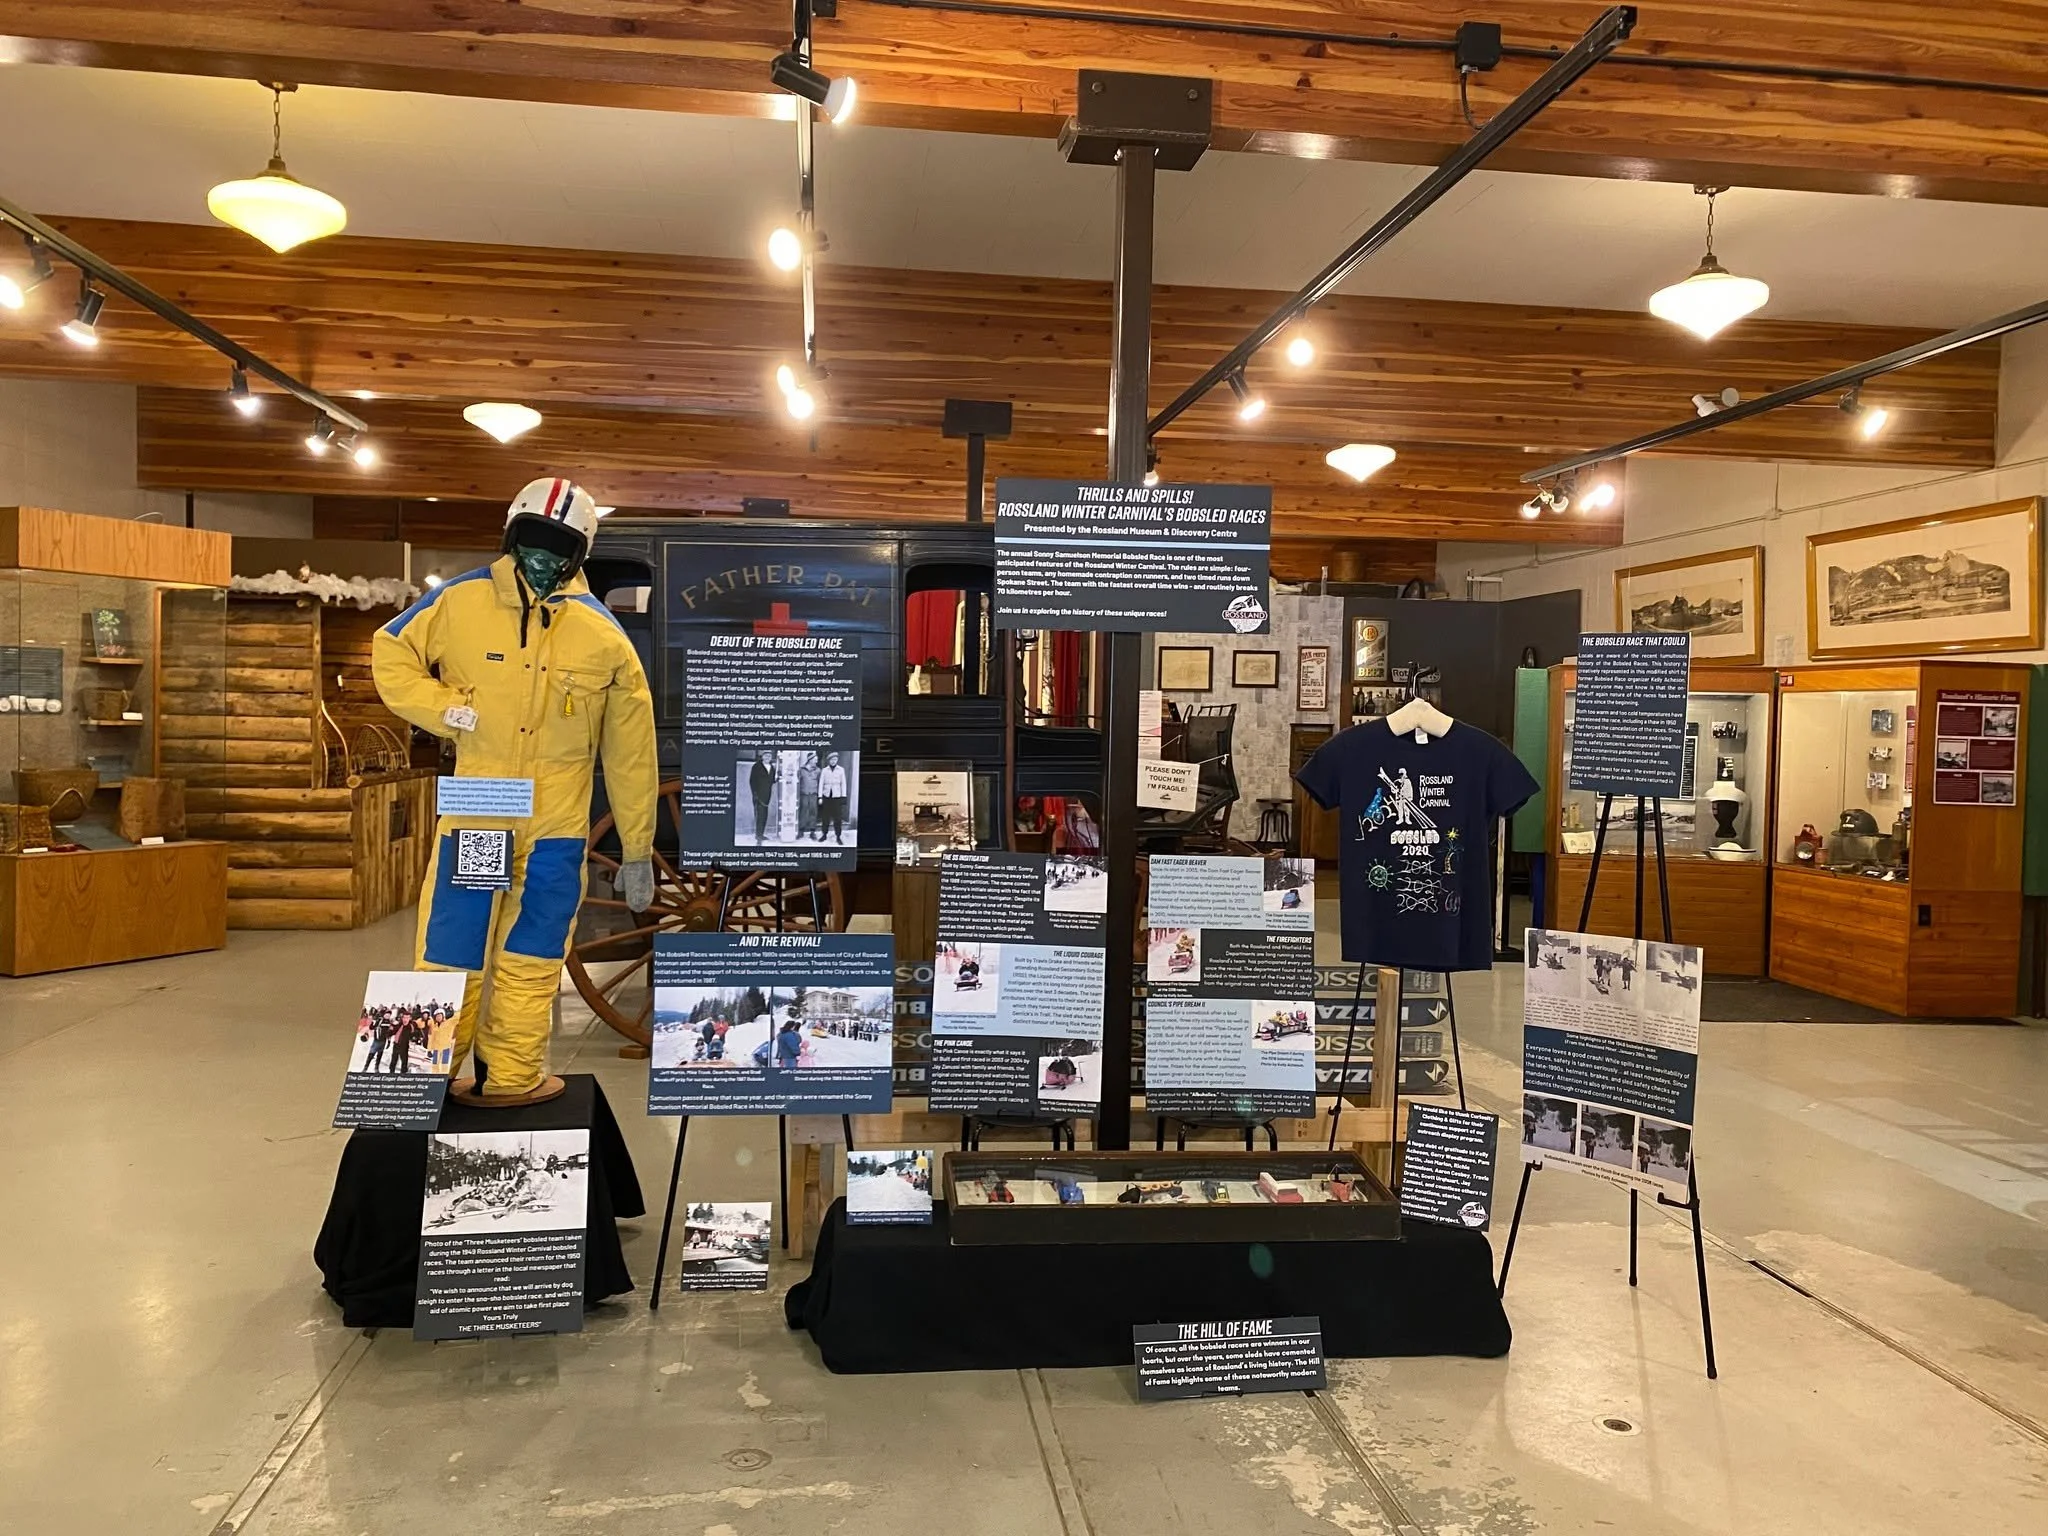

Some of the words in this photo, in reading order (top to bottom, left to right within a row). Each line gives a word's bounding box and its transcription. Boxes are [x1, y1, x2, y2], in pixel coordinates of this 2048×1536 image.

[1078, 487, 1124, 502] THRILLS
[1125, 487, 1150, 502] AND
[1150, 487, 1194, 504] SPILLS!
[998, 503, 1059, 518] ROSSLAND
[1062, 504, 1106, 519] WINTER
[1108, 506, 1174, 521] CARNIVAL'S
[1176, 508, 1227, 522] BOBSLED
[1229, 509, 1266, 523] RACES
[1024, 524, 1065, 532] Presented
[1067, 525, 1076, 535] by
[1093, 526, 1128, 534] Rossland
[1130, 527, 1162, 535] Museum
[1171, 528, 1210, 538] Discovery
[1211, 529, 1237, 537] Centre
[1034, 551, 1054, 559] Sonny
[680, 564, 804, 609] FATHER
[822, 570, 878, 606] PAT
[1029, 608, 1060, 616] exploring
[1224, 610, 1266, 619] ROSSLAND
[710, 636, 742, 647] DEBUT
[742, 637, 755, 647] OF
[757, 637, 775, 648] THE
[775, 638, 817, 649] BOBSLED
[818, 638, 843, 649] RACE
[1583, 637, 1595, 646] THE
[1595, 637, 1625, 646] BOBSLED
[1626, 637, 1644, 646] RACE
[1645, 637, 1662, 645] THAT
[1663, 637, 1686, 645] COULD
[1358, 667, 1385, 677] BEER
[1158, 784, 1187, 792] FRAGILE!
[1390, 830, 1440, 845] BOBSLED
[1402, 845, 1429, 856] 2020
[739, 936, 759, 946] AND
[762, 936, 779, 946] THE
[780, 936, 821, 947] REVIVAL!
[1526, 1044, 1551, 1052] Everyone
[1653, 1067, 1683, 1079] inevitability
[1178, 1325, 1198, 1339] THE
[1200, 1323, 1224, 1338] HILL
[1226, 1322, 1240, 1336] OF
[1242, 1320, 1273, 1335] FAME
[1200, 1342, 1226, 1350] bobsled
